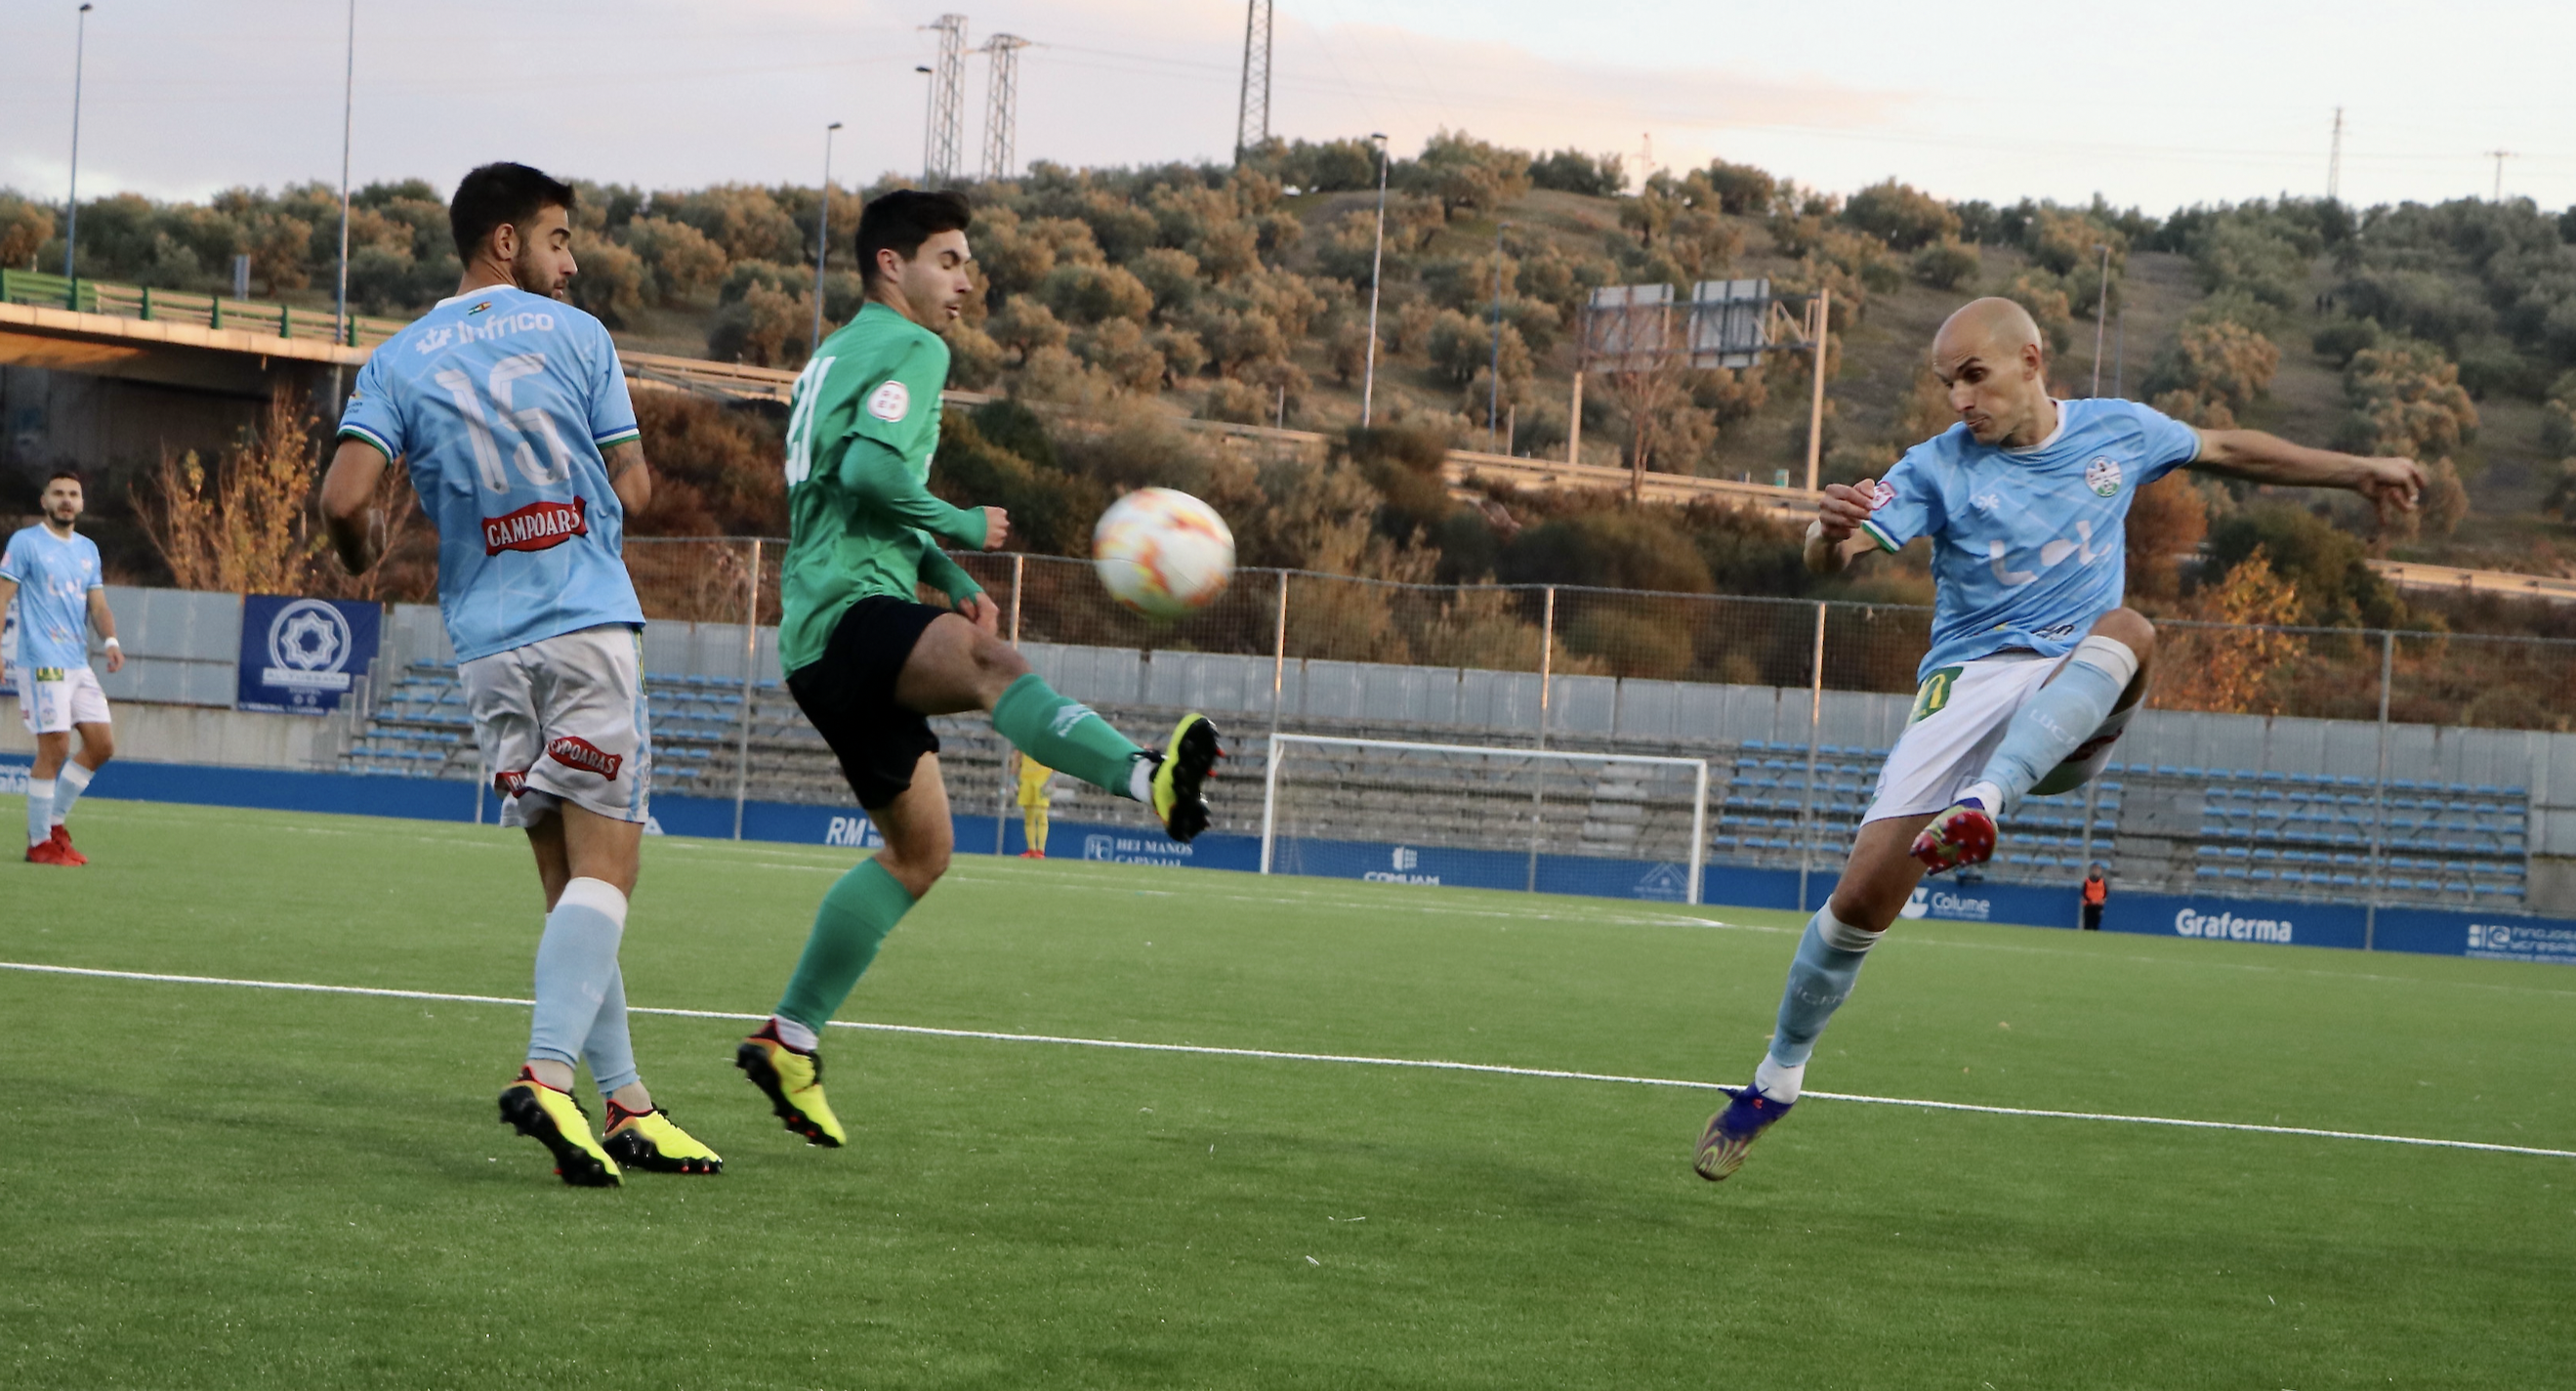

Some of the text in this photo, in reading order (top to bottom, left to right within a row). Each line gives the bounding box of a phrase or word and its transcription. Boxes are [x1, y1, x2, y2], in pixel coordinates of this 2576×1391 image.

[435, 353, 572, 495] 15
[825, 816, 867, 846] RM
[1932, 892, 1990, 913] Colume
[2175, 907, 2293, 943] Graferma
